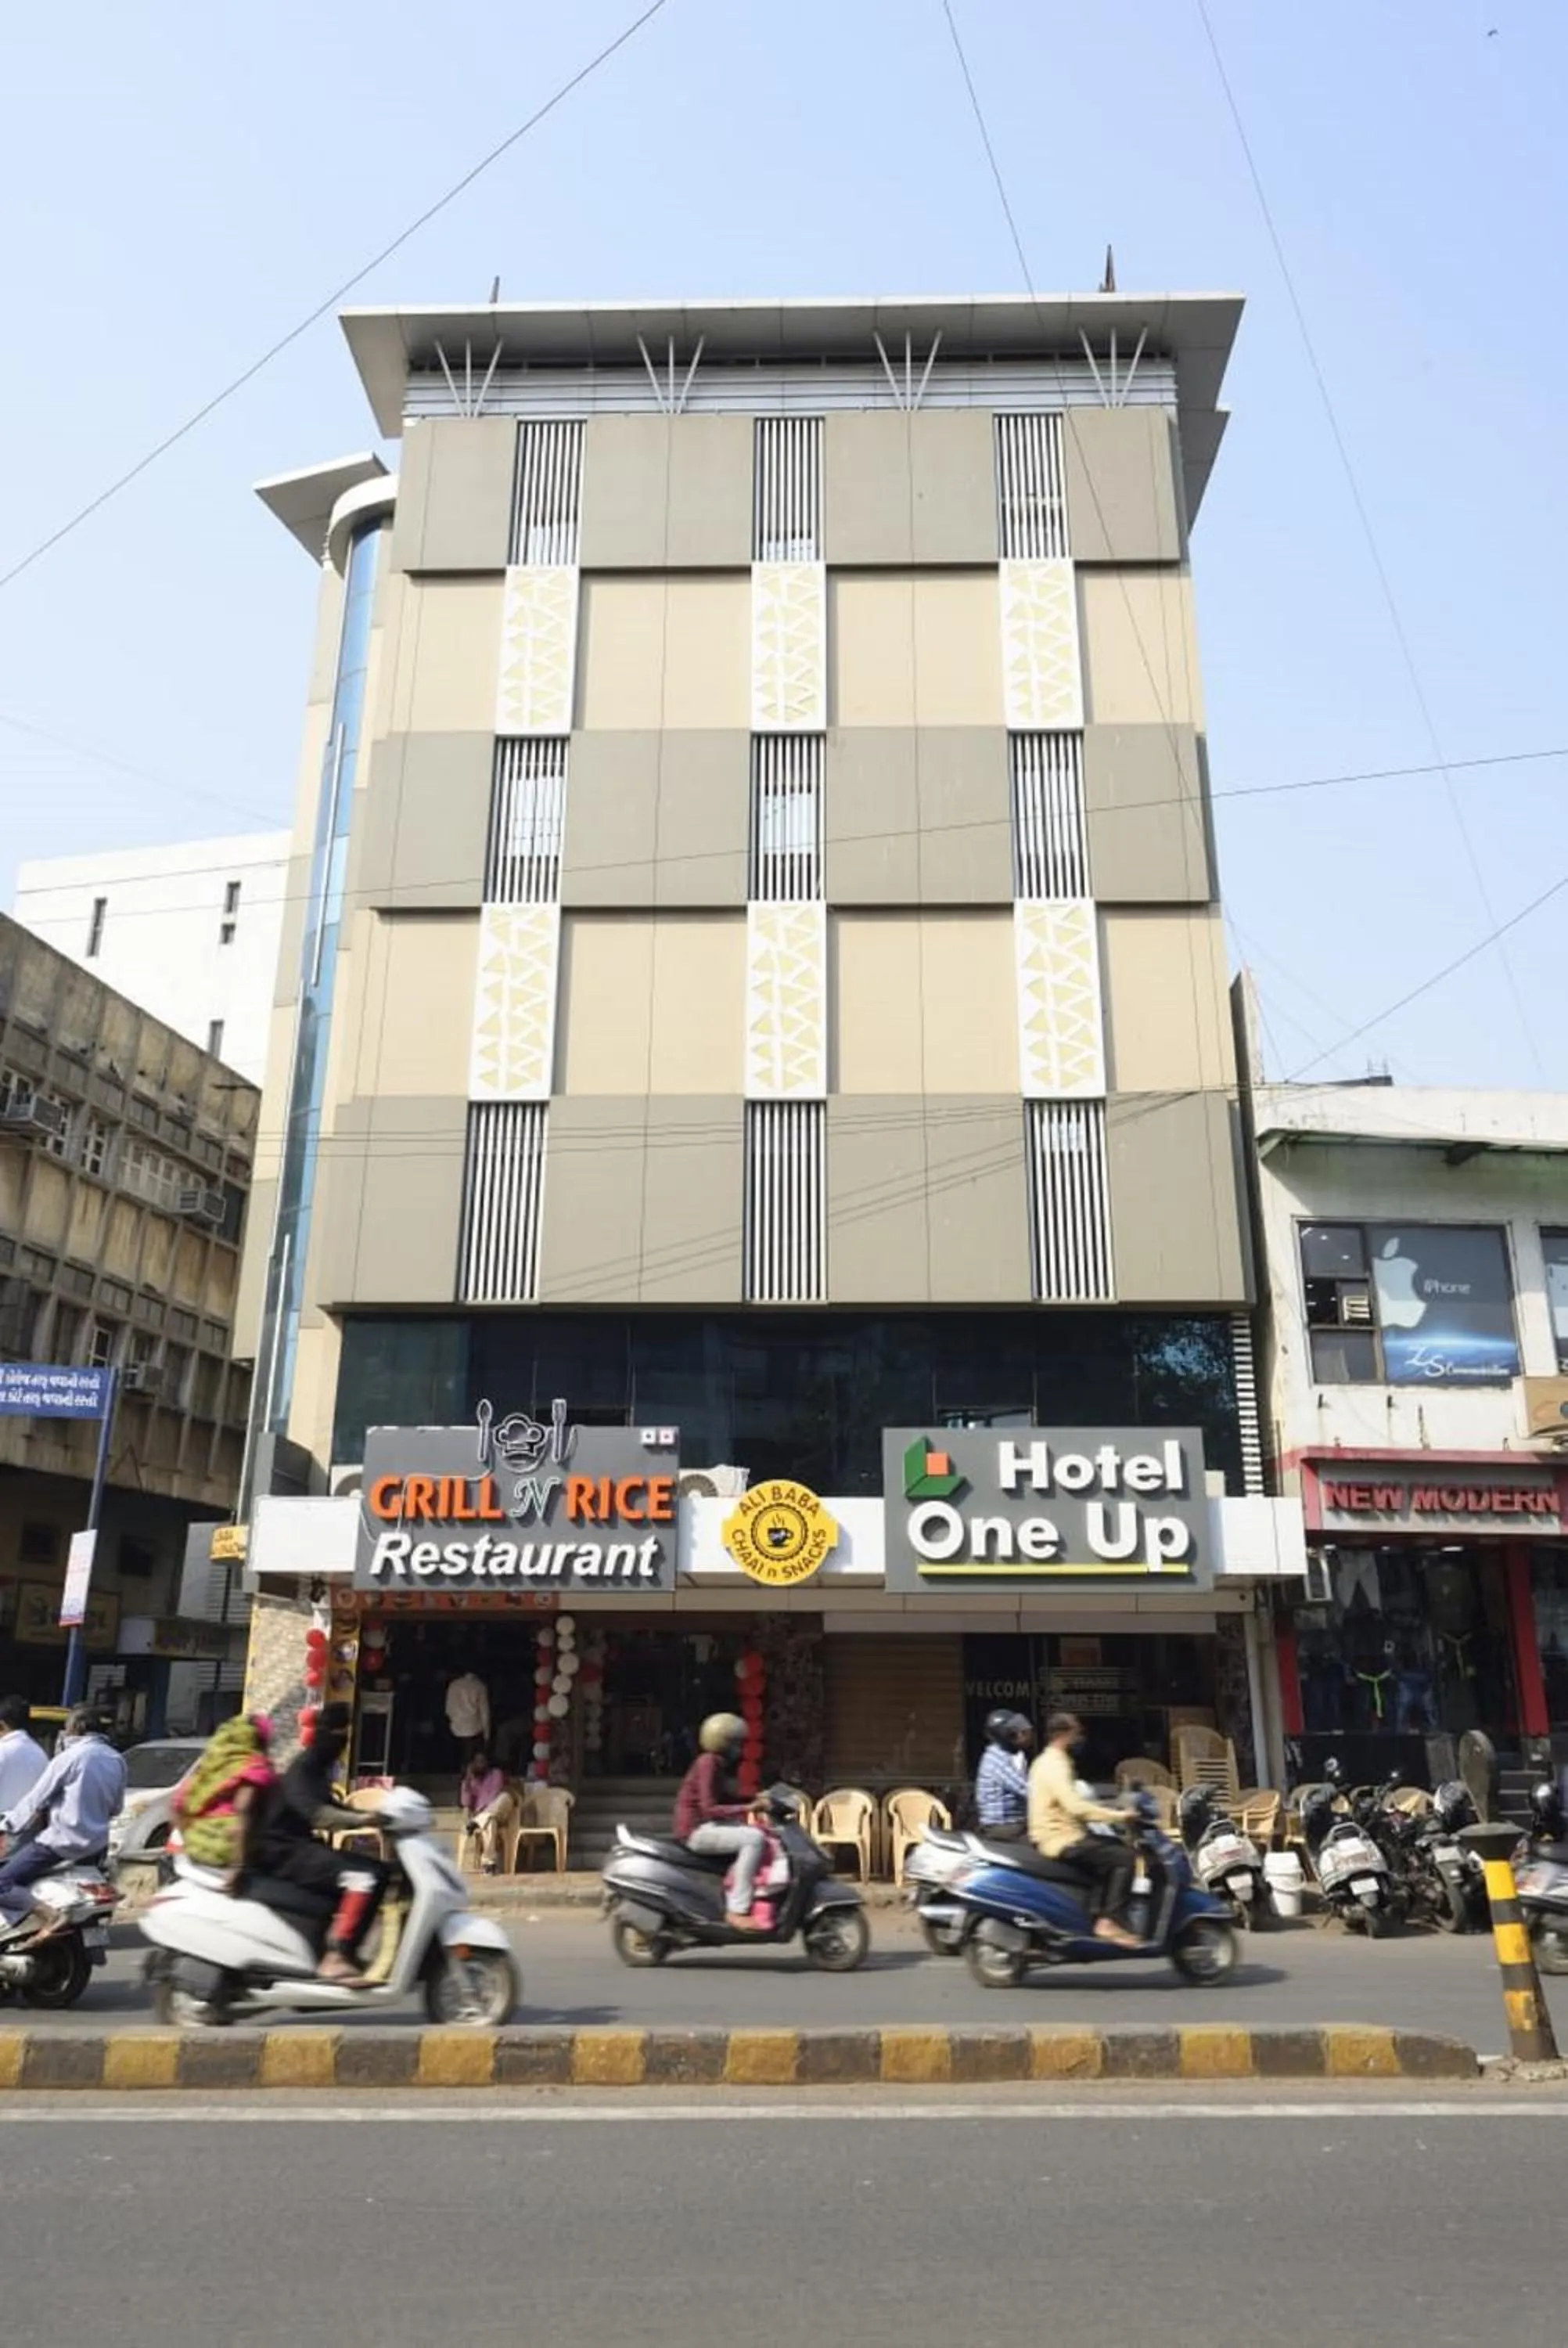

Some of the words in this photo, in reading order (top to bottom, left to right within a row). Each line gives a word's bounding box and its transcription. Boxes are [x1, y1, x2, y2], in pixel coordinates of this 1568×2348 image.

[1424, 1278, 1471, 1295] iPhone
[998, 1440, 1183, 1490] Hotel
[369, 1474, 505, 1520] GRILL
[509, 1476, 561, 1519] N
[566, 1475, 675, 1520] RICE
[739, 1489, 766, 1517] ALI
[771, 1485, 820, 1518] BABA
[1325, 1482, 1404, 1511] NEW
[1412, 1485, 1561, 1513] MODERN
[369, 1532, 659, 1576] Restaurant
[781, 1529, 827, 1579] SNACKS
[908, 1500, 1060, 1559] One
[1086, 1501, 1190, 1573] Up
